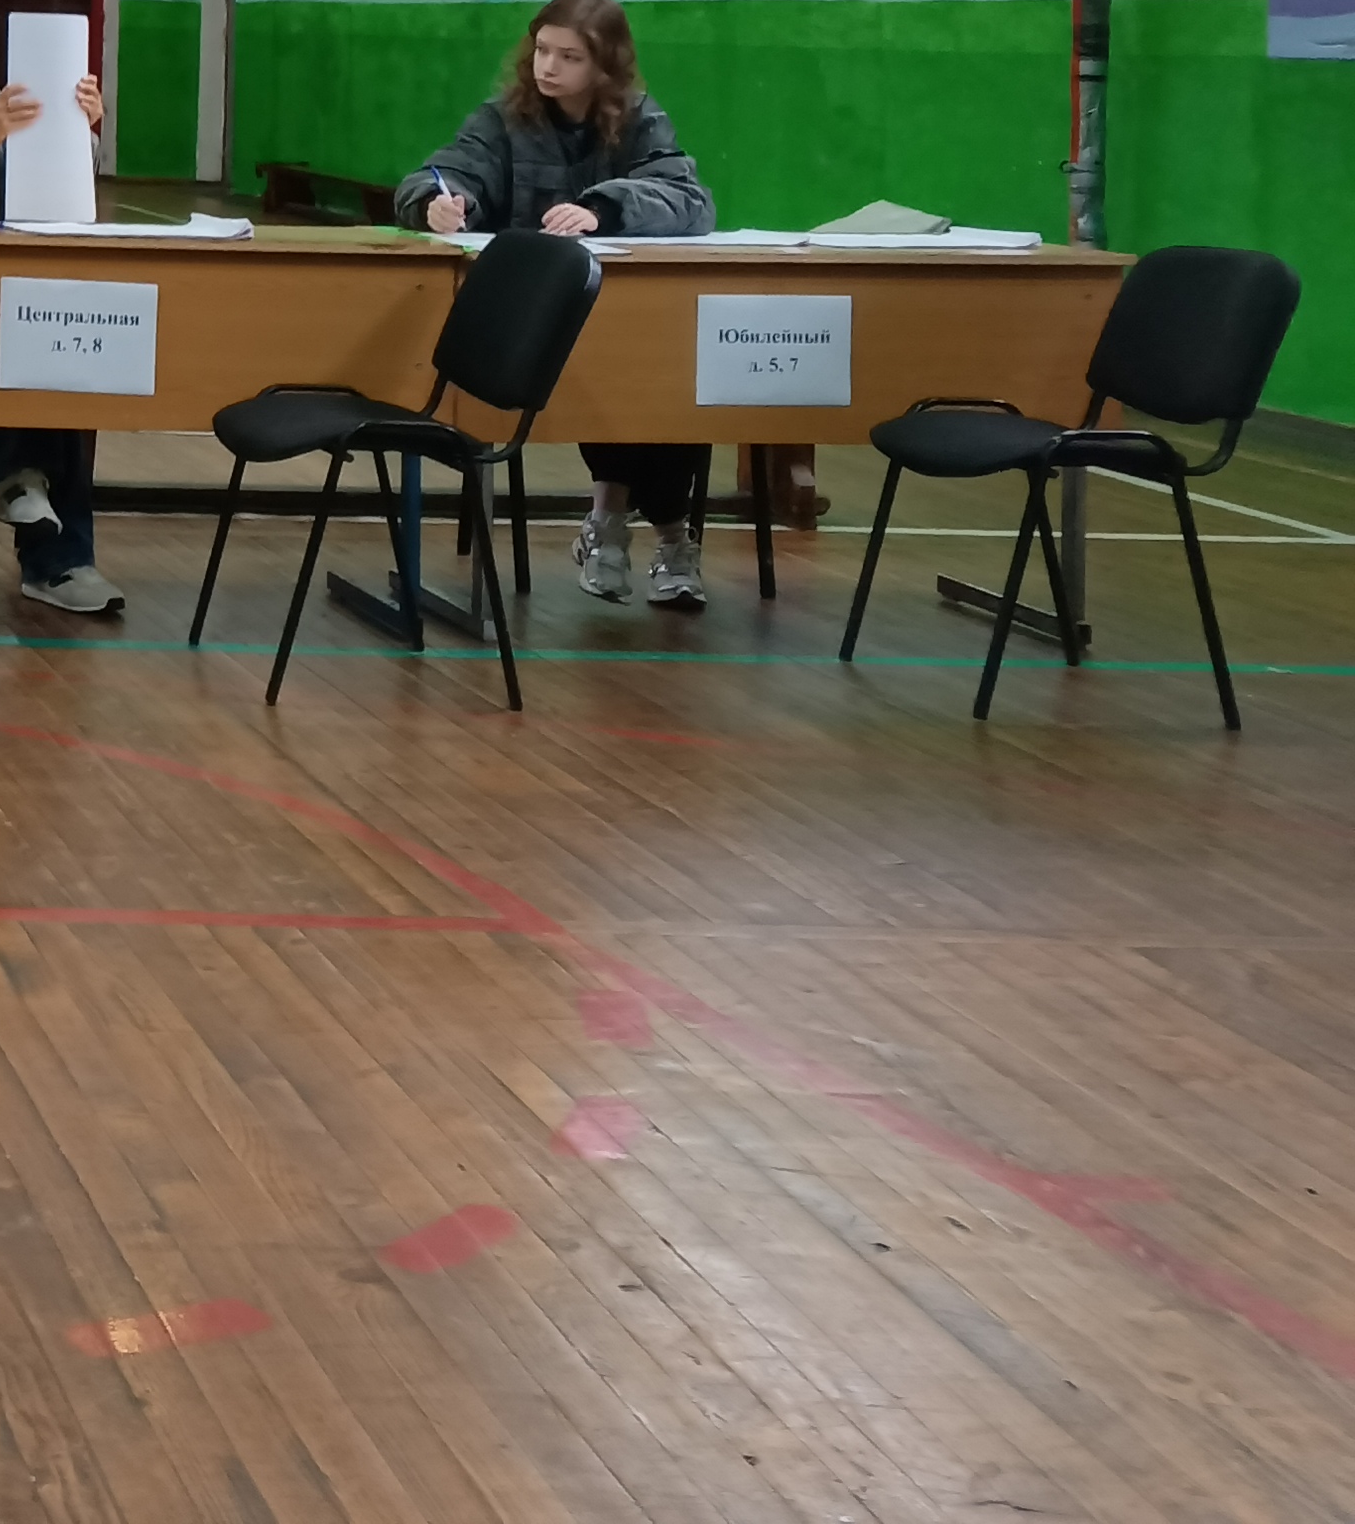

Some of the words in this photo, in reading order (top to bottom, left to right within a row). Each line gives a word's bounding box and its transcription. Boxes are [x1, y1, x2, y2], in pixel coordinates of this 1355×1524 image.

[17, 306, 139, 326] Центральная
[718, 328, 831, 344] Юбилейный
[51, 340, 67, 352] д.
[73, 337, 88, 354] 7,
[92, 337, 102, 354] 8
[748, 361, 763, 373] д.
[789, 357, 799, 372] 7
